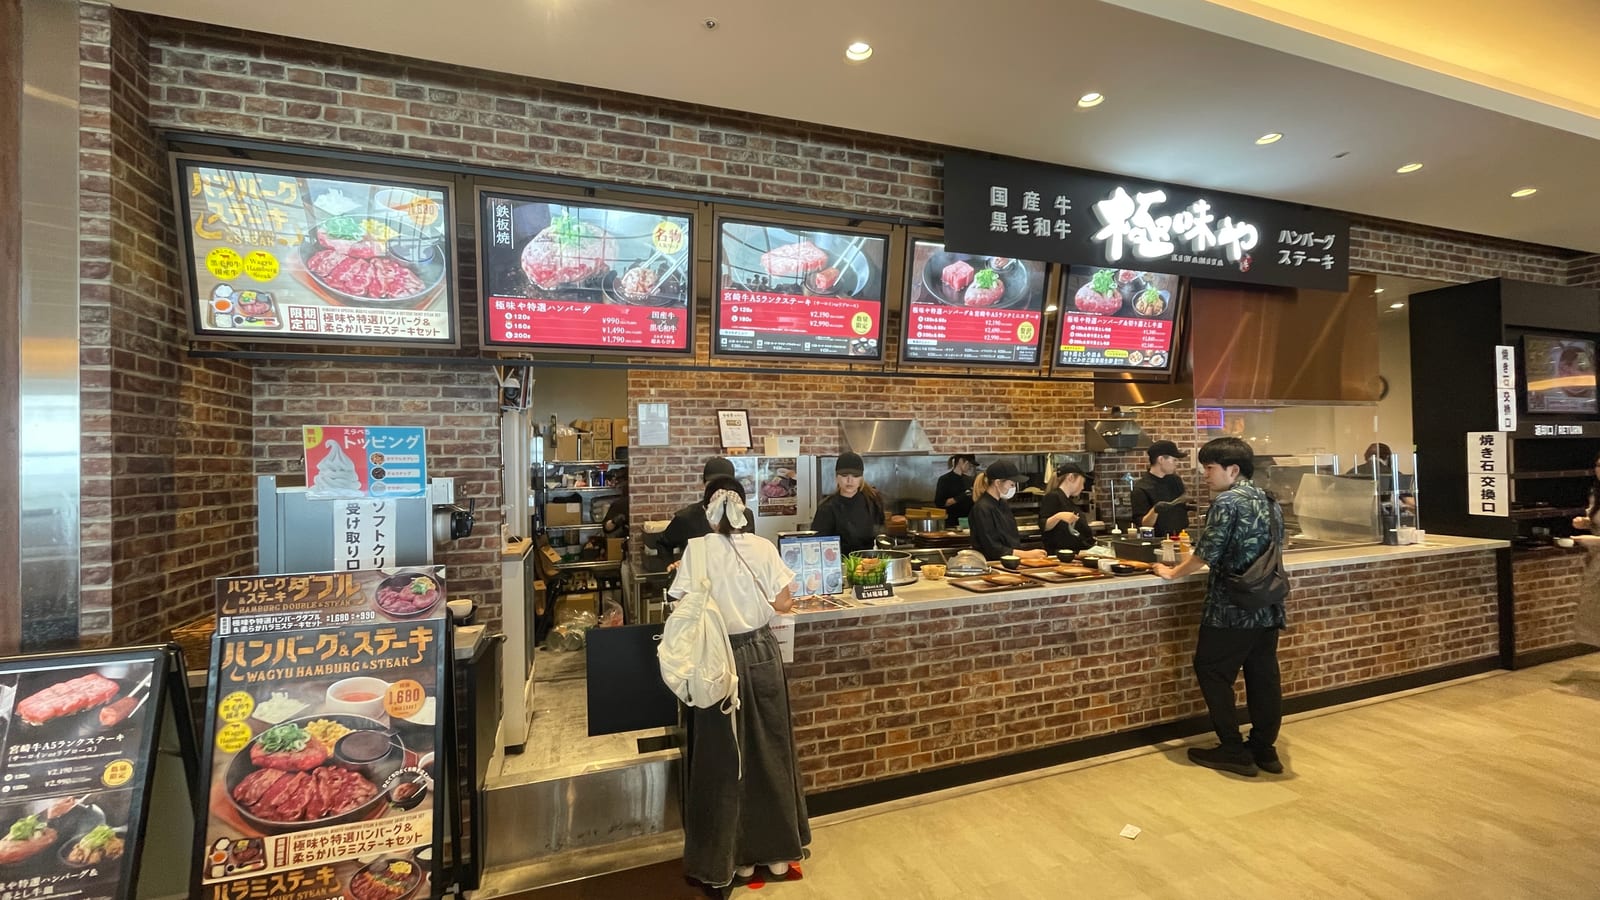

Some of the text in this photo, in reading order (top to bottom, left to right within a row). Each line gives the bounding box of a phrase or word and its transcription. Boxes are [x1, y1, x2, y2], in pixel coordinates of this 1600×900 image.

[990, 186, 1071, 216] 国産牛
[496, 204, 510, 245] 鉄板焼
[656, 228, 681, 243] 名物
[990, 211, 1071, 240] 黒毛和牛
[1092, 187, 1258, 262] 極味や
[1278, 230, 1336, 250] ハンバーグ
[1171, 254, 1224, 266] KIWAMIYA
[1278, 250, 1335, 270] ステーキ
[724, 292, 811, 307] 宮崎牛A5ランクステーキ
[651, 311, 675, 319] 国産牛
[324, 323, 440, 337] 柔らかハラミステーキセット
[650, 324, 677, 333] 黒毛和牛
[344, 435, 421, 449] トッピング
[1479, 434, 1495, 512] 焼き石 交換口
[346, 503, 361, 570] 受け取り口
[372, 501, 386, 569] ソフトクリ
[228, 577, 288, 594] ハンバーグ
[288, 574, 361, 601] ダブル
[239, 603, 280, 614] HAMBURG
[283, 601, 317, 610] DOUBLE
[323, 600, 351, 608] STEAK
[246, 669, 293, 682] WAGYU
[296, 659, 360, 678] HAMBURG
[369, 656, 409, 670] STEAK
[9, 733, 125, 755] 宮崎牛A5ランクステーキ
[293, 832, 423, 865] 柔らかハラミステーキセット
[214, 866, 335, 900] ハラミステーキ
